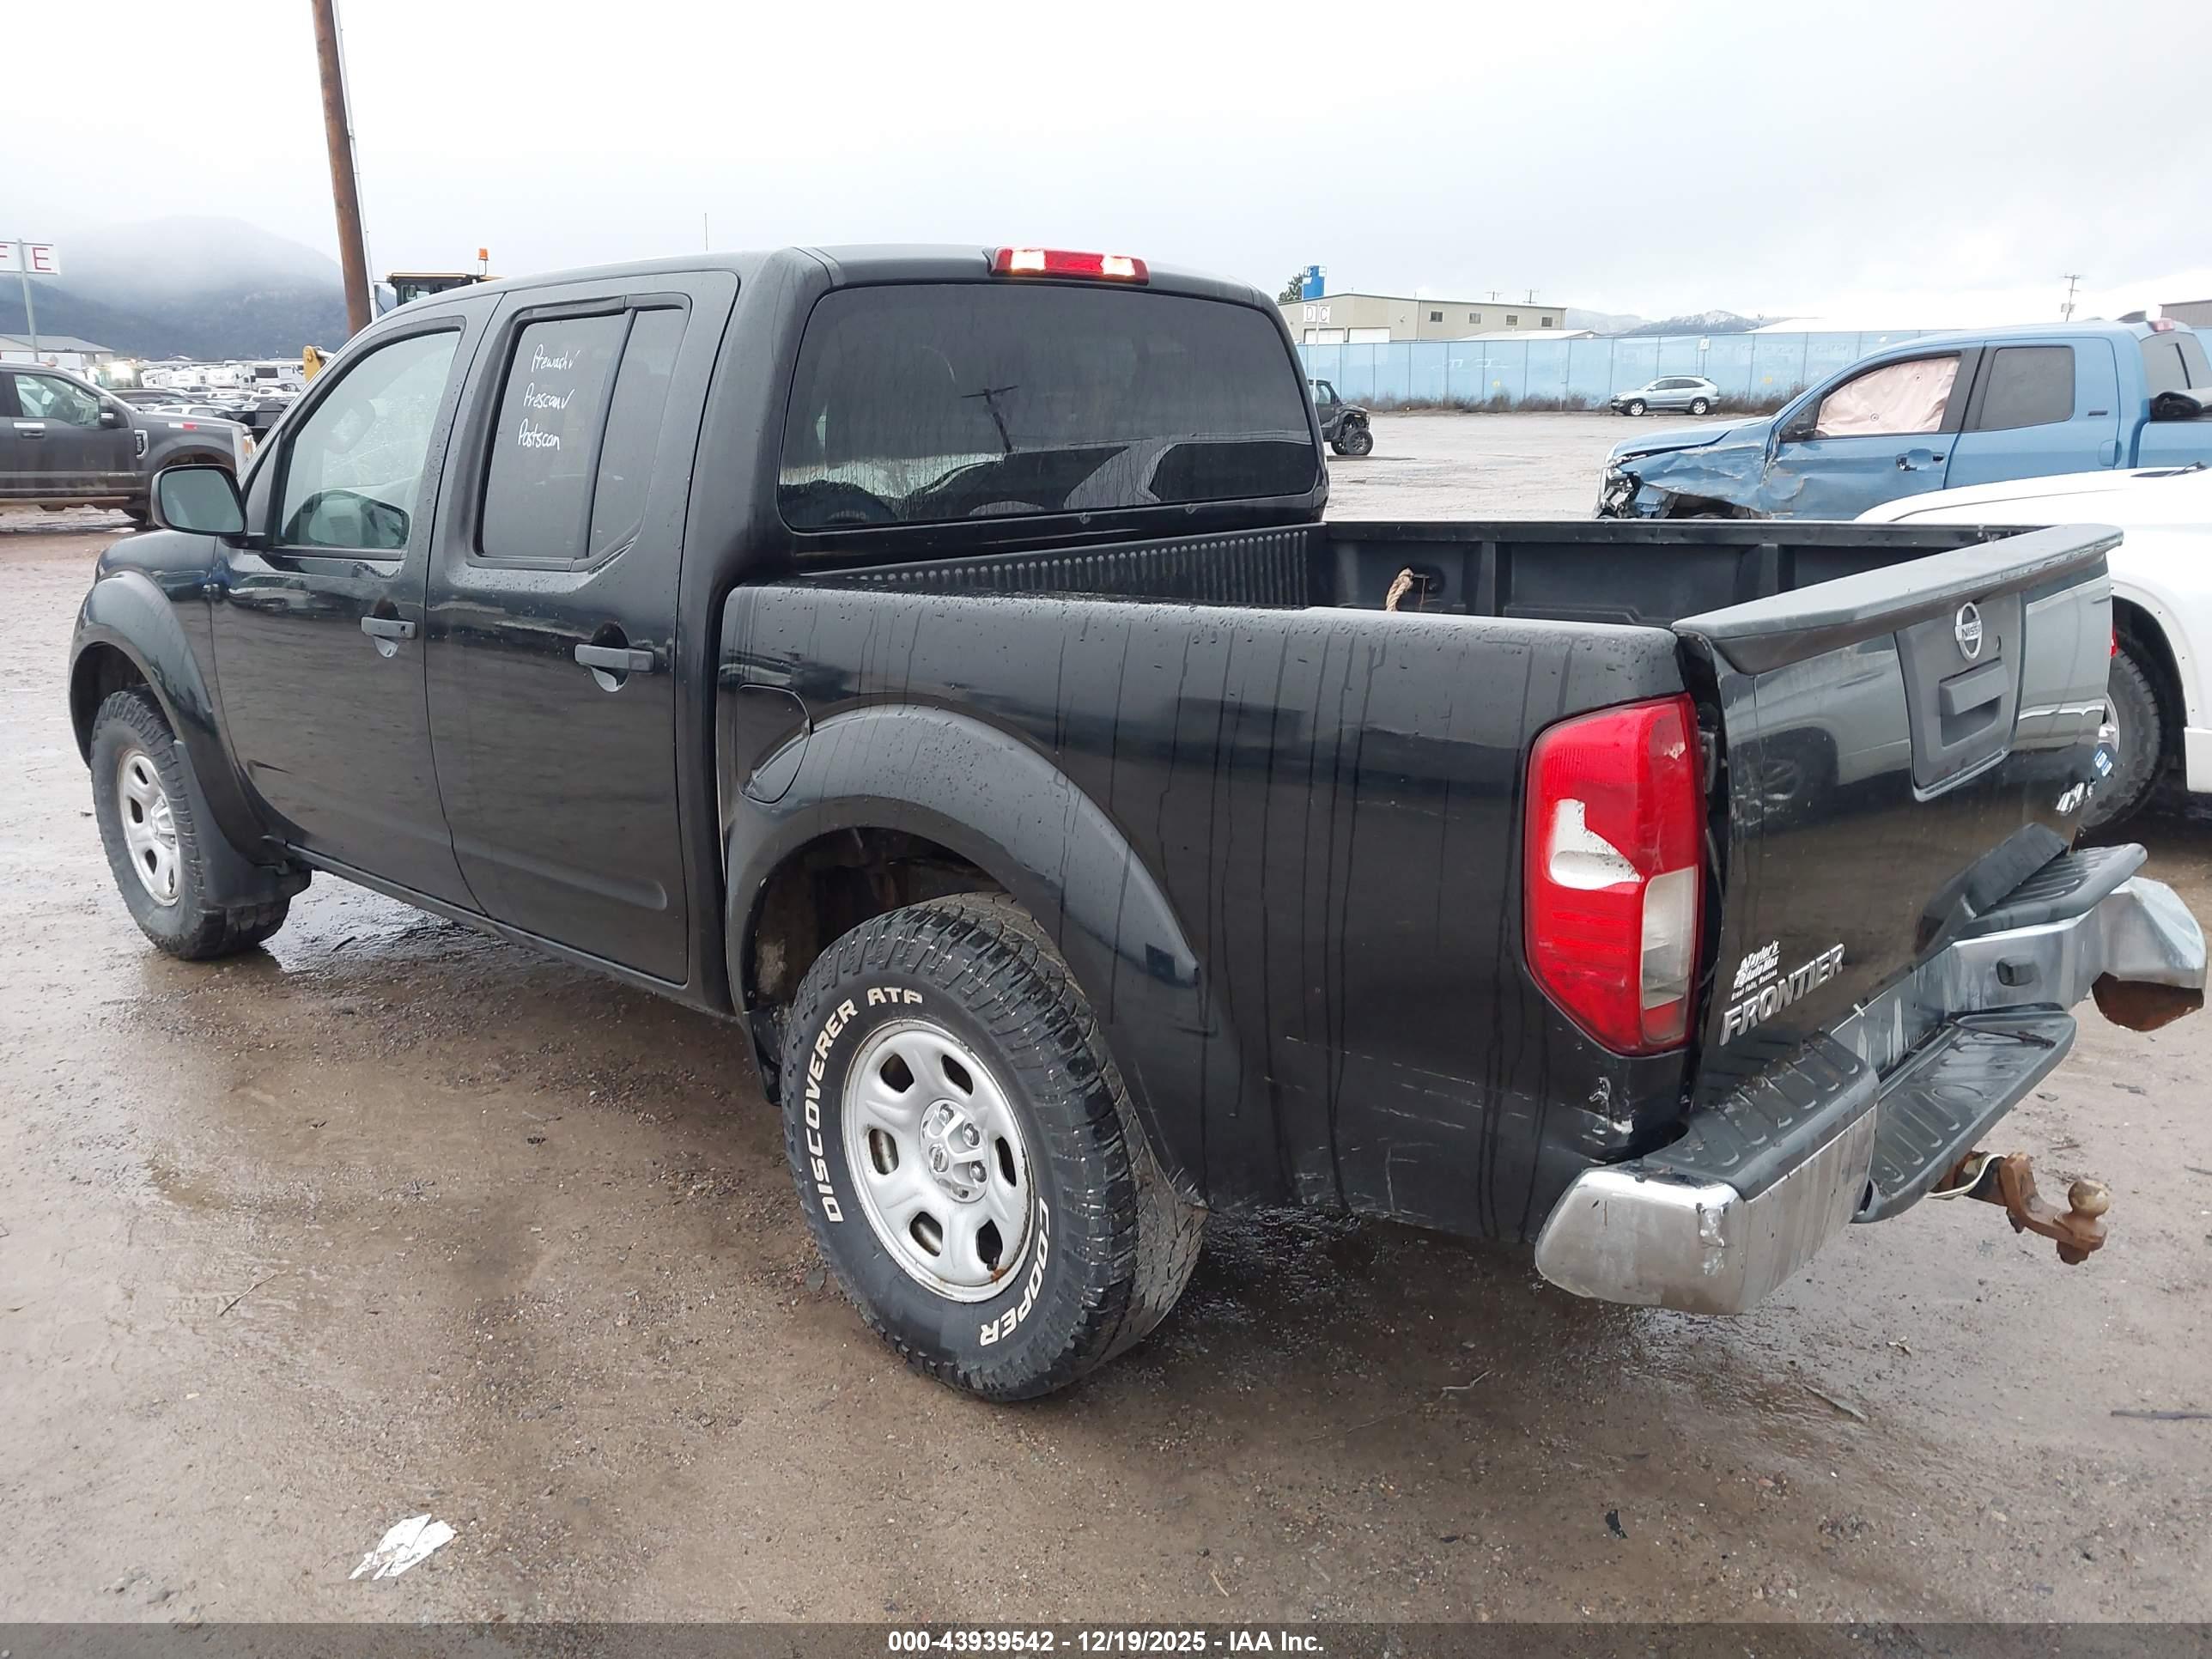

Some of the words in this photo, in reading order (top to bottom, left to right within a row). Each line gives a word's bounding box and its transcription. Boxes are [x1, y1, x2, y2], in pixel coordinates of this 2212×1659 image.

[32, 246, 52, 270] E
[1306, 306, 1314, 321] D
[1320, 307, 1328, 322] C
[518, 417, 561, 451] Postscan
[1719, 943, 1845, 1046] FRONTIER
[804, 998, 860, 1224] DISCOVERER
[866, 987, 924, 1007] ATP
[979, 1196, 1050, 1348] COOPER
